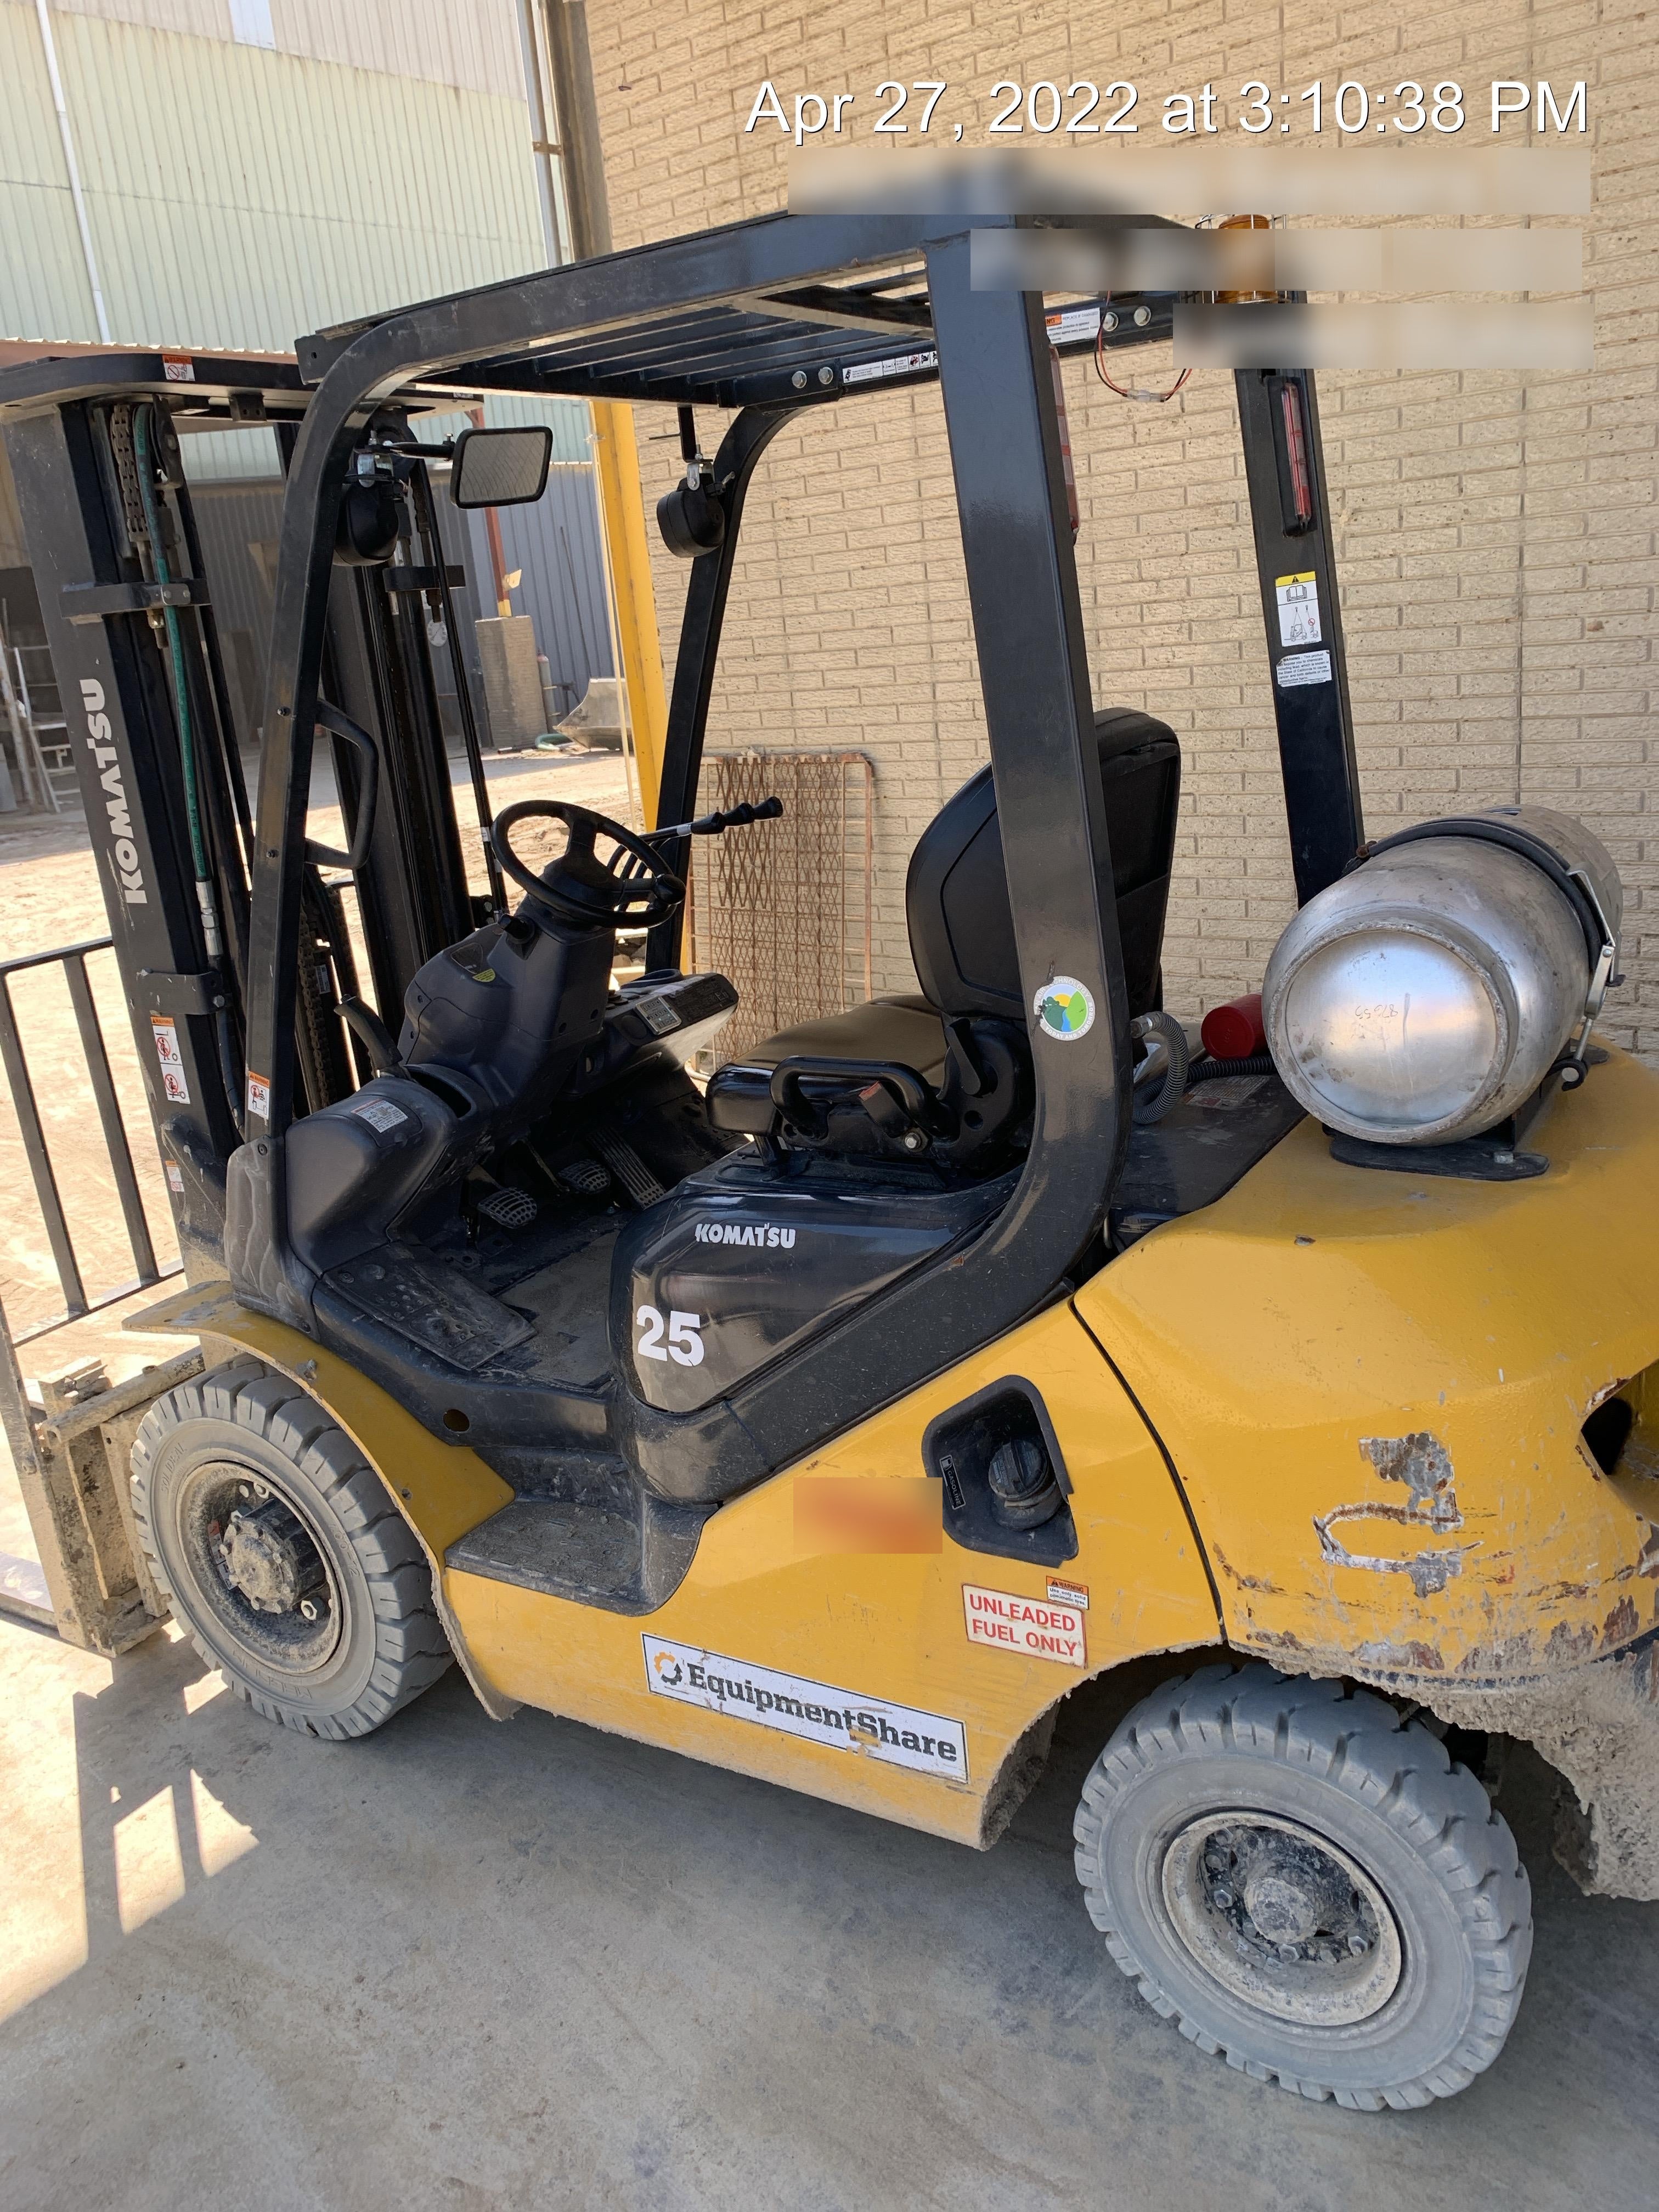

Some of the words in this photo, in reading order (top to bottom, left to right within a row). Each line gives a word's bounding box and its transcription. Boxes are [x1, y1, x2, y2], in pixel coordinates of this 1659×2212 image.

[79, 678, 148, 904] KOMATSU
[1047, 978, 1090, 998] CHNOLOGY
[1045, 1025, 1064, 1039] TODAY
[1079, 1002, 1094, 1035] TOMORROW
[695, 1222, 796, 1249] KOMATSU
[636, 1305, 704, 1367] 25
[947, 1470, 961, 1506] GASOLINE
[1059, 1581, 1084, 1593] WARNING
[969, 1593, 1075, 1632] UNLEADED
[972, 1618, 1020, 1645] FUEL
[1025, 1631, 1077, 1657] ONLY
[687, 1663, 957, 1763] EquipmentShare
